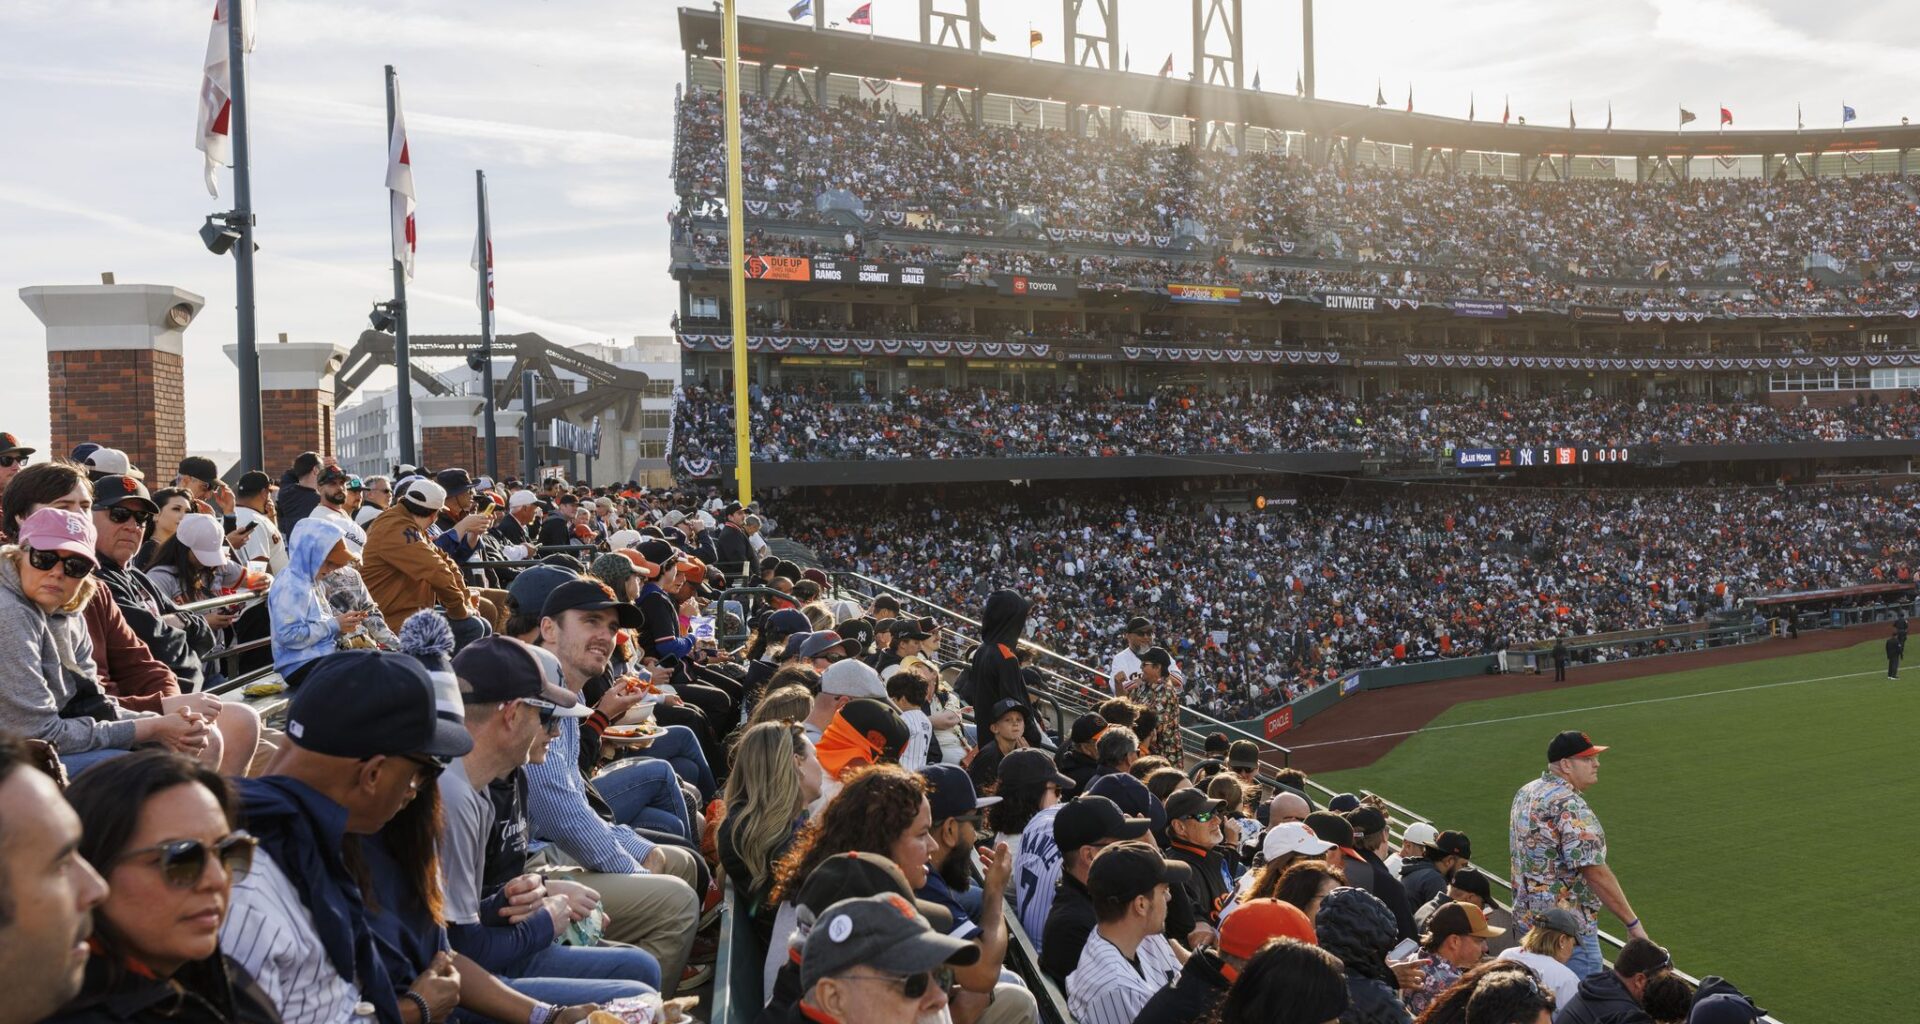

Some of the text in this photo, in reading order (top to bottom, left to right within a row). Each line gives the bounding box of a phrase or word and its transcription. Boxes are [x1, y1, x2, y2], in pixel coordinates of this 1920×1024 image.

[771, 258, 802, 268] DUE UP
[815, 269, 841, 280] RAMOS
[859, 272, 889, 282] SCHMITT
[902, 274, 925, 284] BAILEY
[1028, 282, 1057, 291] TOYOTA
[1326, 295, 1374, 310] CUTWATER
[1461, 452, 1491, 464] BLUE MOON
[1520, 448, 1532, 465] NY
[1543, 450, 1549, 463] 5
[1583, 449, 1588, 461] 0
[1600, 449, 1605, 461] 0
[1611, 449, 1616, 461] 0
[1622, 449, 1628, 461] 0
[857, 630, 867, 642] NY
[1268, 713, 1288, 733] ORACLE
[1020, 866, 1039, 925] 7
